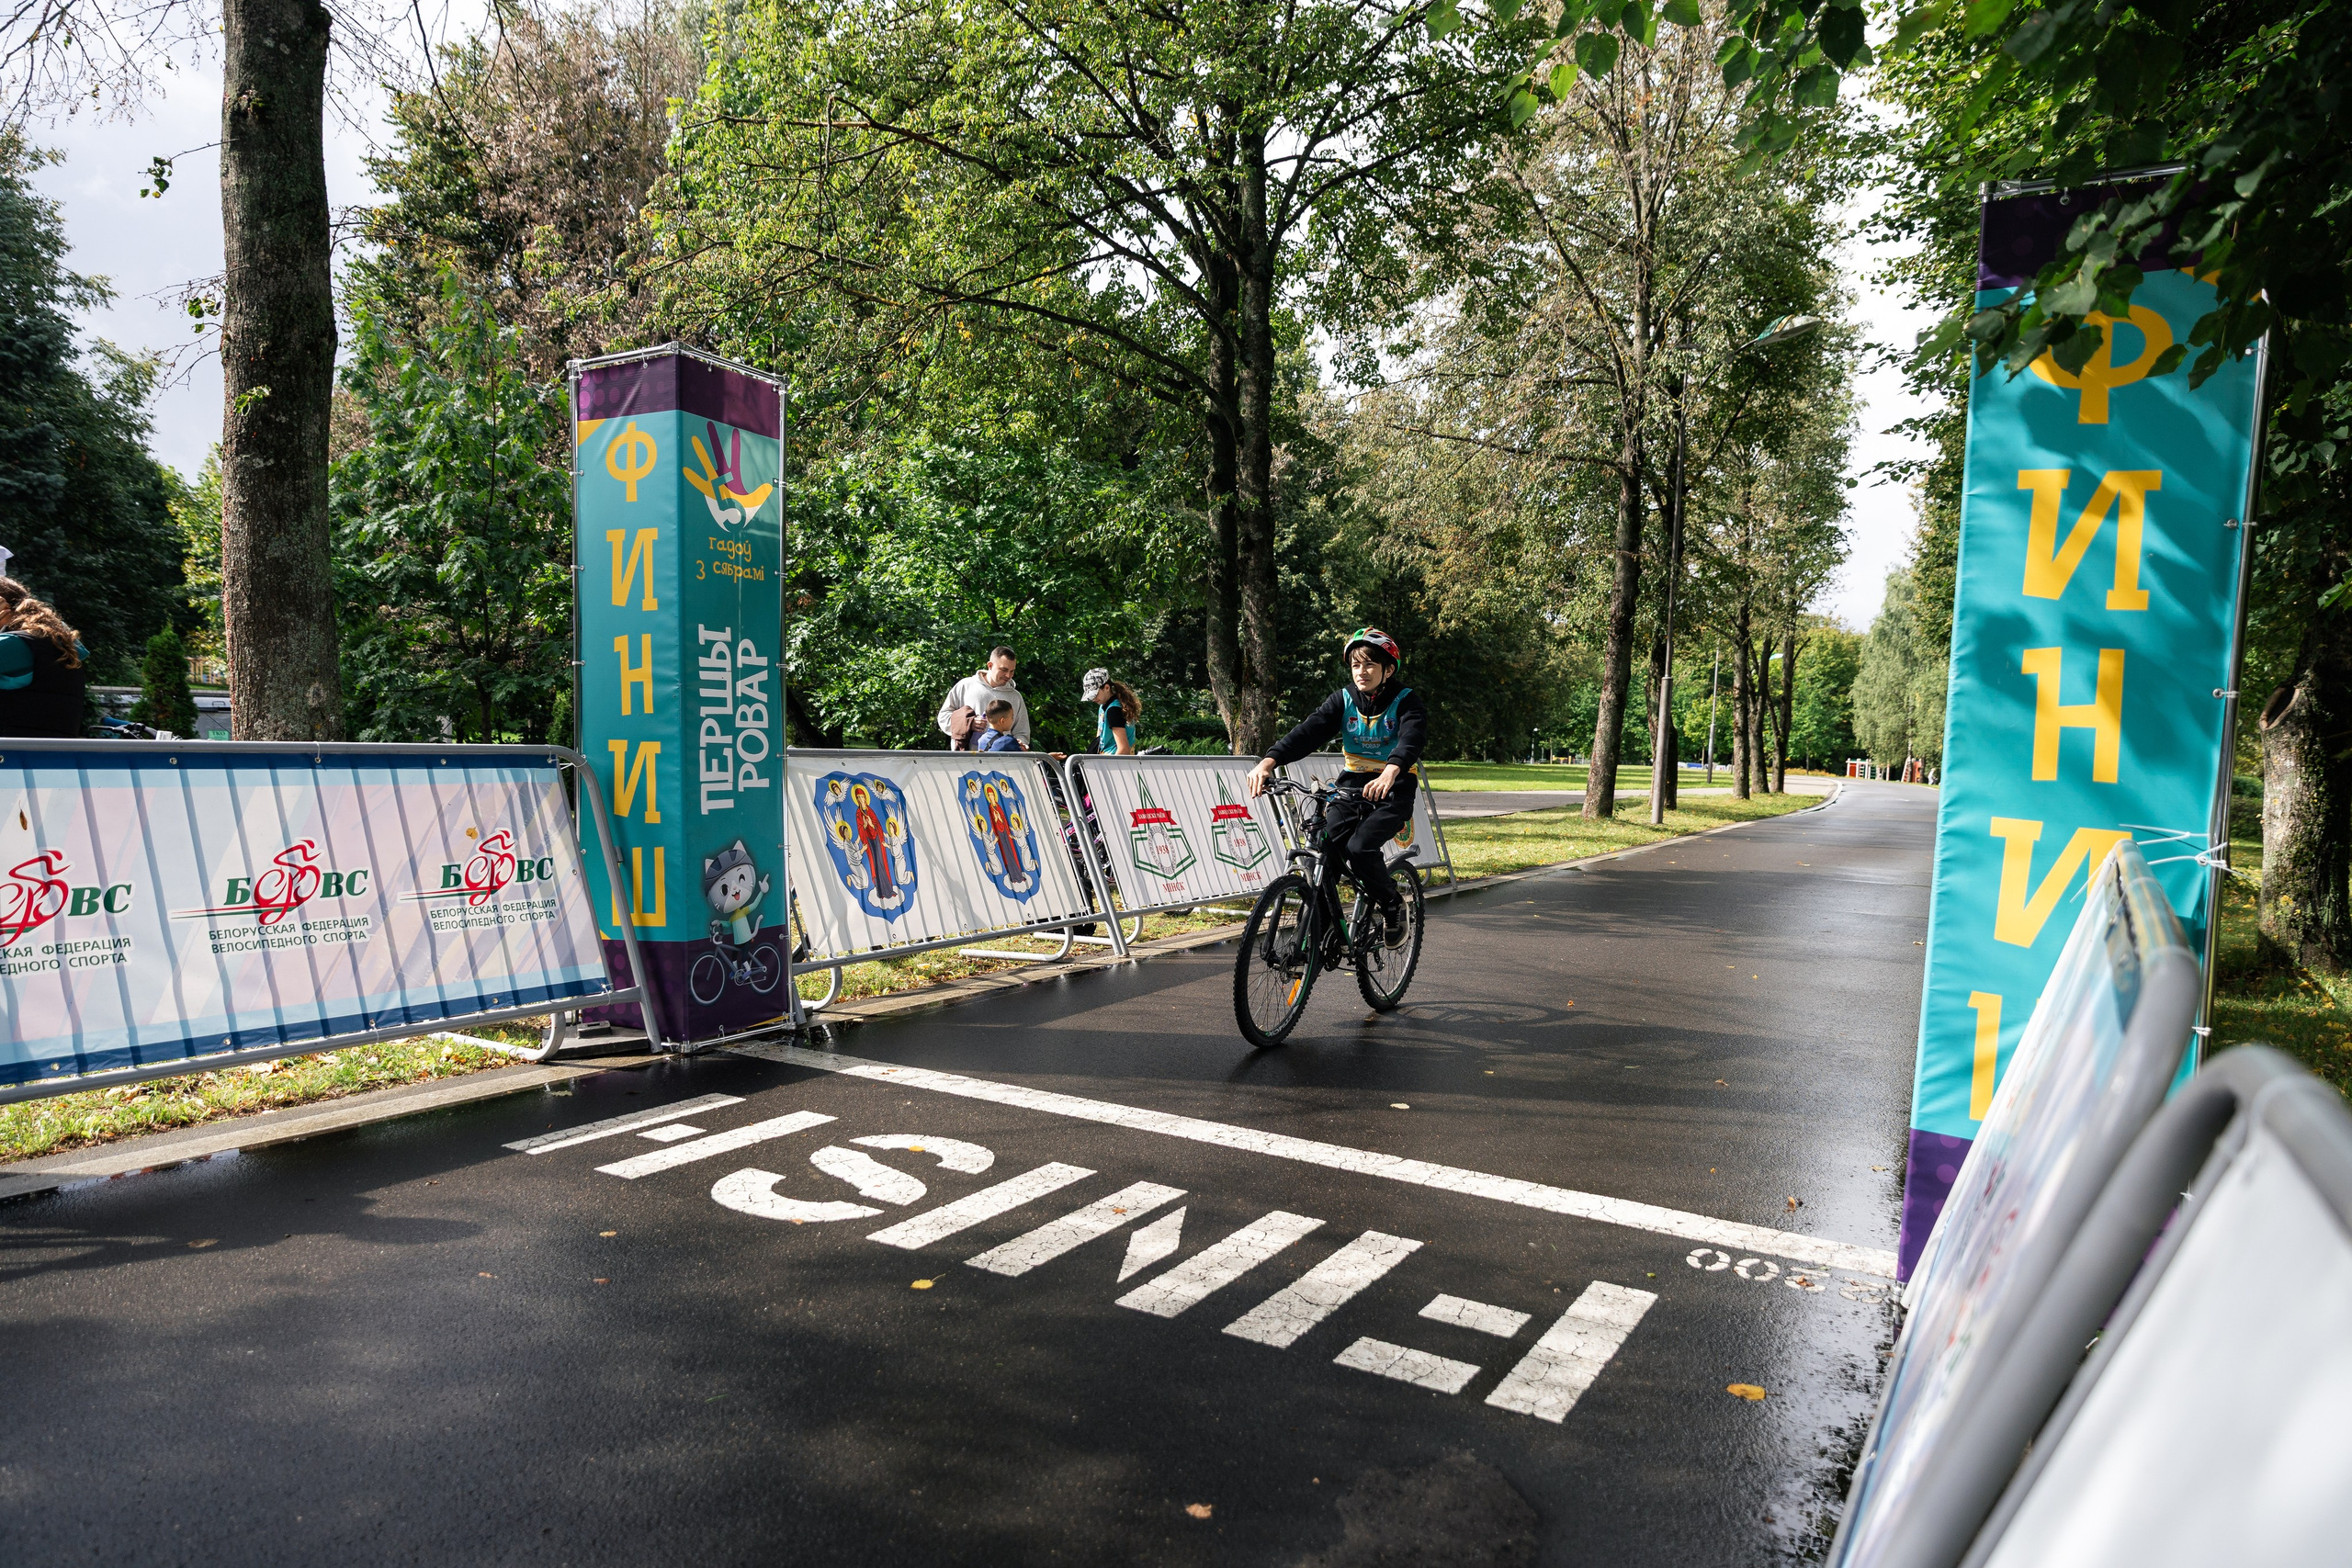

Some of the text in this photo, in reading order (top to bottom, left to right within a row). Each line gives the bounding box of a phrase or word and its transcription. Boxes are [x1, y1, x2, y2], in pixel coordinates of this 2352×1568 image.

[605, 421, 667, 928] ФИНИШ
[698, 623, 735, 816] ПЕРШЫ
[736, 638, 770, 793] РОВАР
[1967, 301, 2174, 1122] ФИНИ
[1155, 844, 1170, 855] 1938
[1233, 838, 1247, 848] 1938
[430, 898, 557, 919] БЕЛОРУССКАЯ ФЕДЕРАЦИЯ
[209, 917, 369, 941] БЕЛОРУССКАЯ ФЕДЕРАЦИЯ
[434, 910, 556, 931] ВЕЛОСИПЕДНОГО СПОРТА
[41, 937, 131, 955] ФЕДЕРАЦИЯ
[211, 931, 367, 954] ВЕЛОСИПЕДНОГО СПОРТА
[69, 953, 128, 968] СПОРТА
[502, 1093, 1658, 1424] FINISH
